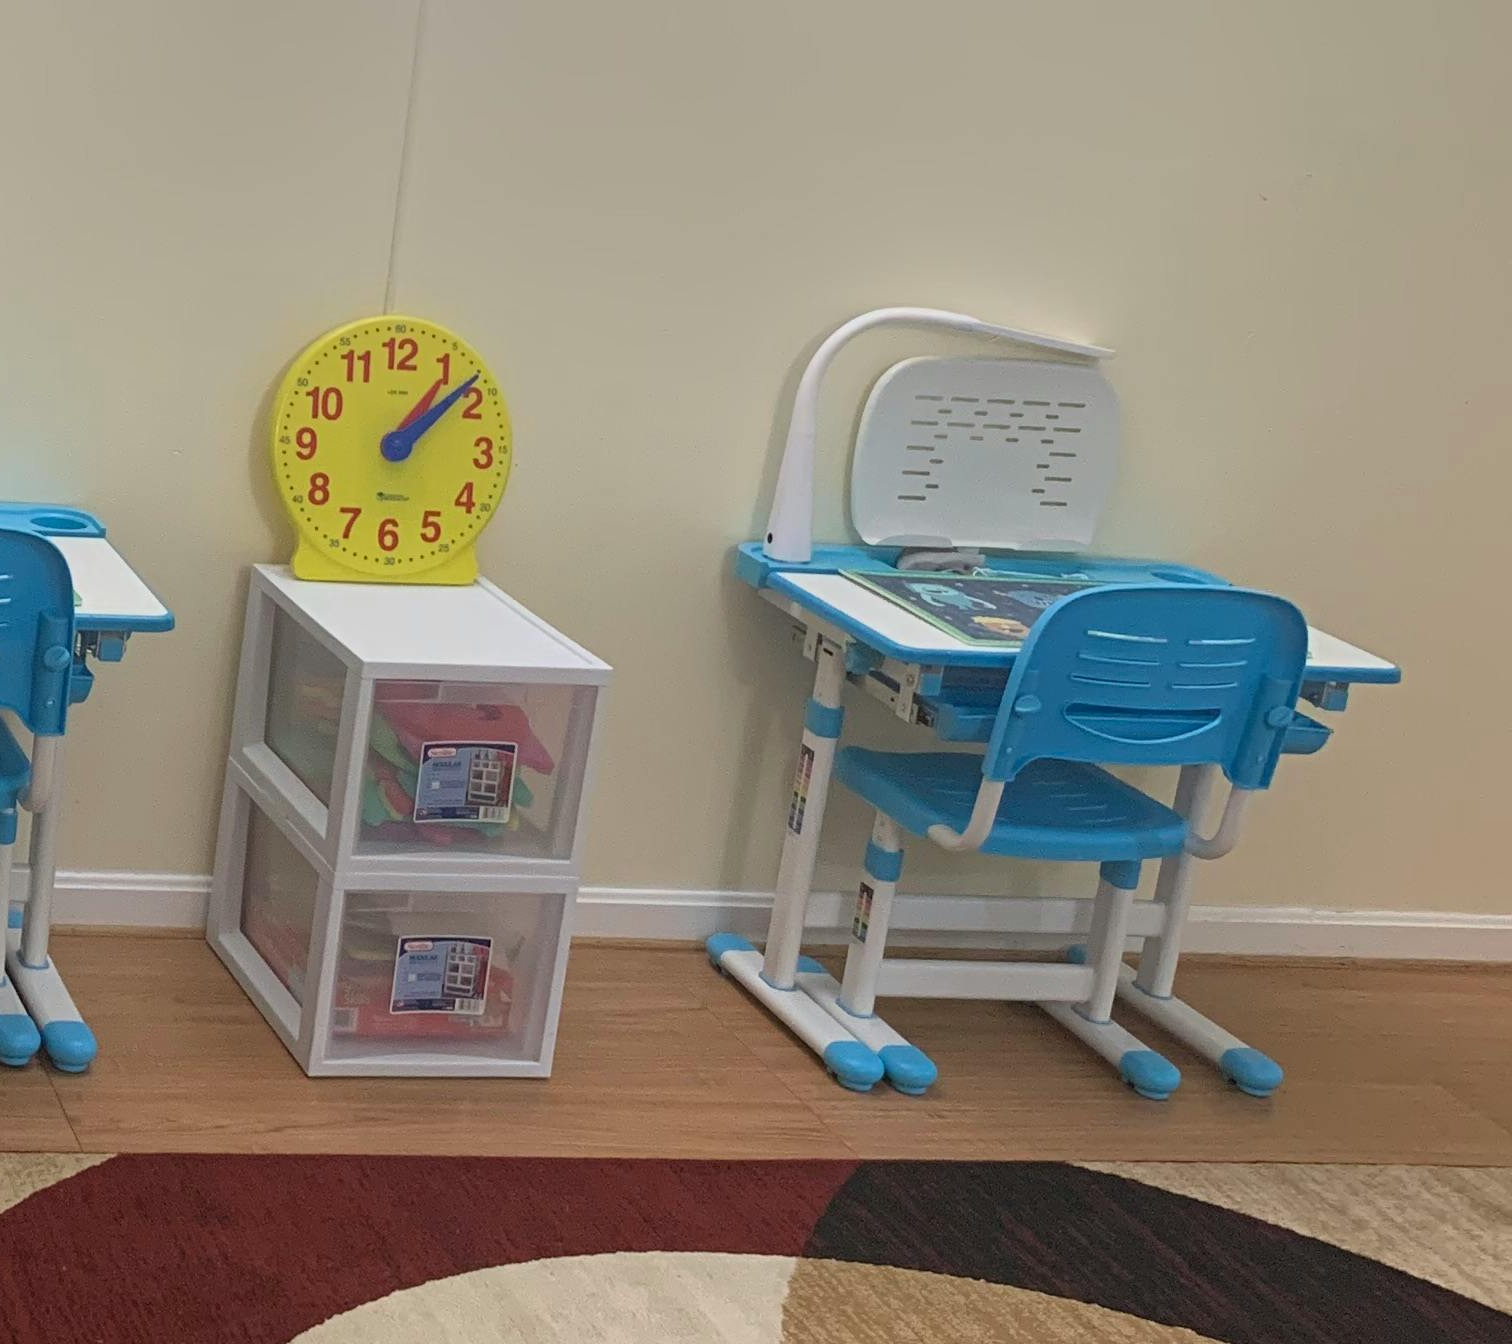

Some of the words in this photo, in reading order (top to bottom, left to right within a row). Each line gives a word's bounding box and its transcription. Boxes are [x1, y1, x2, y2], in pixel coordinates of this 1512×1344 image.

[395, 324, 406, 333] 60
[339, 337, 351, 346] 55
[452, 341, 458, 351] 5
[382, 337, 418, 371] 12
[340, 350, 371, 383] 11
[436, 353, 450, 385] 1
[297, 377, 309, 387] 50
[487, 387, 498, 396] 10
[305, 386, 343, 420] 10
[462, 387, 483, 420] 2
[279, 435, 291, 445] 45
[295, 427, 318, 460] 9
[498, 445, 508, 454] 15
[472, 437, 493, 469] 3
[292, 494, 303, 503] 40
[308, 472, 330, 505] 8
[454, 482, 476, 514] 4
[479, 503, 491, 512] 20
[339, 507, 362, 539] 7
[420, 510, 441, 543] 5
[329, 539, 340, 548] 35
[378, 518, 399, 551] 6
[438, 543, 449, 552] 25
[384, 557, 395, 565] 30
